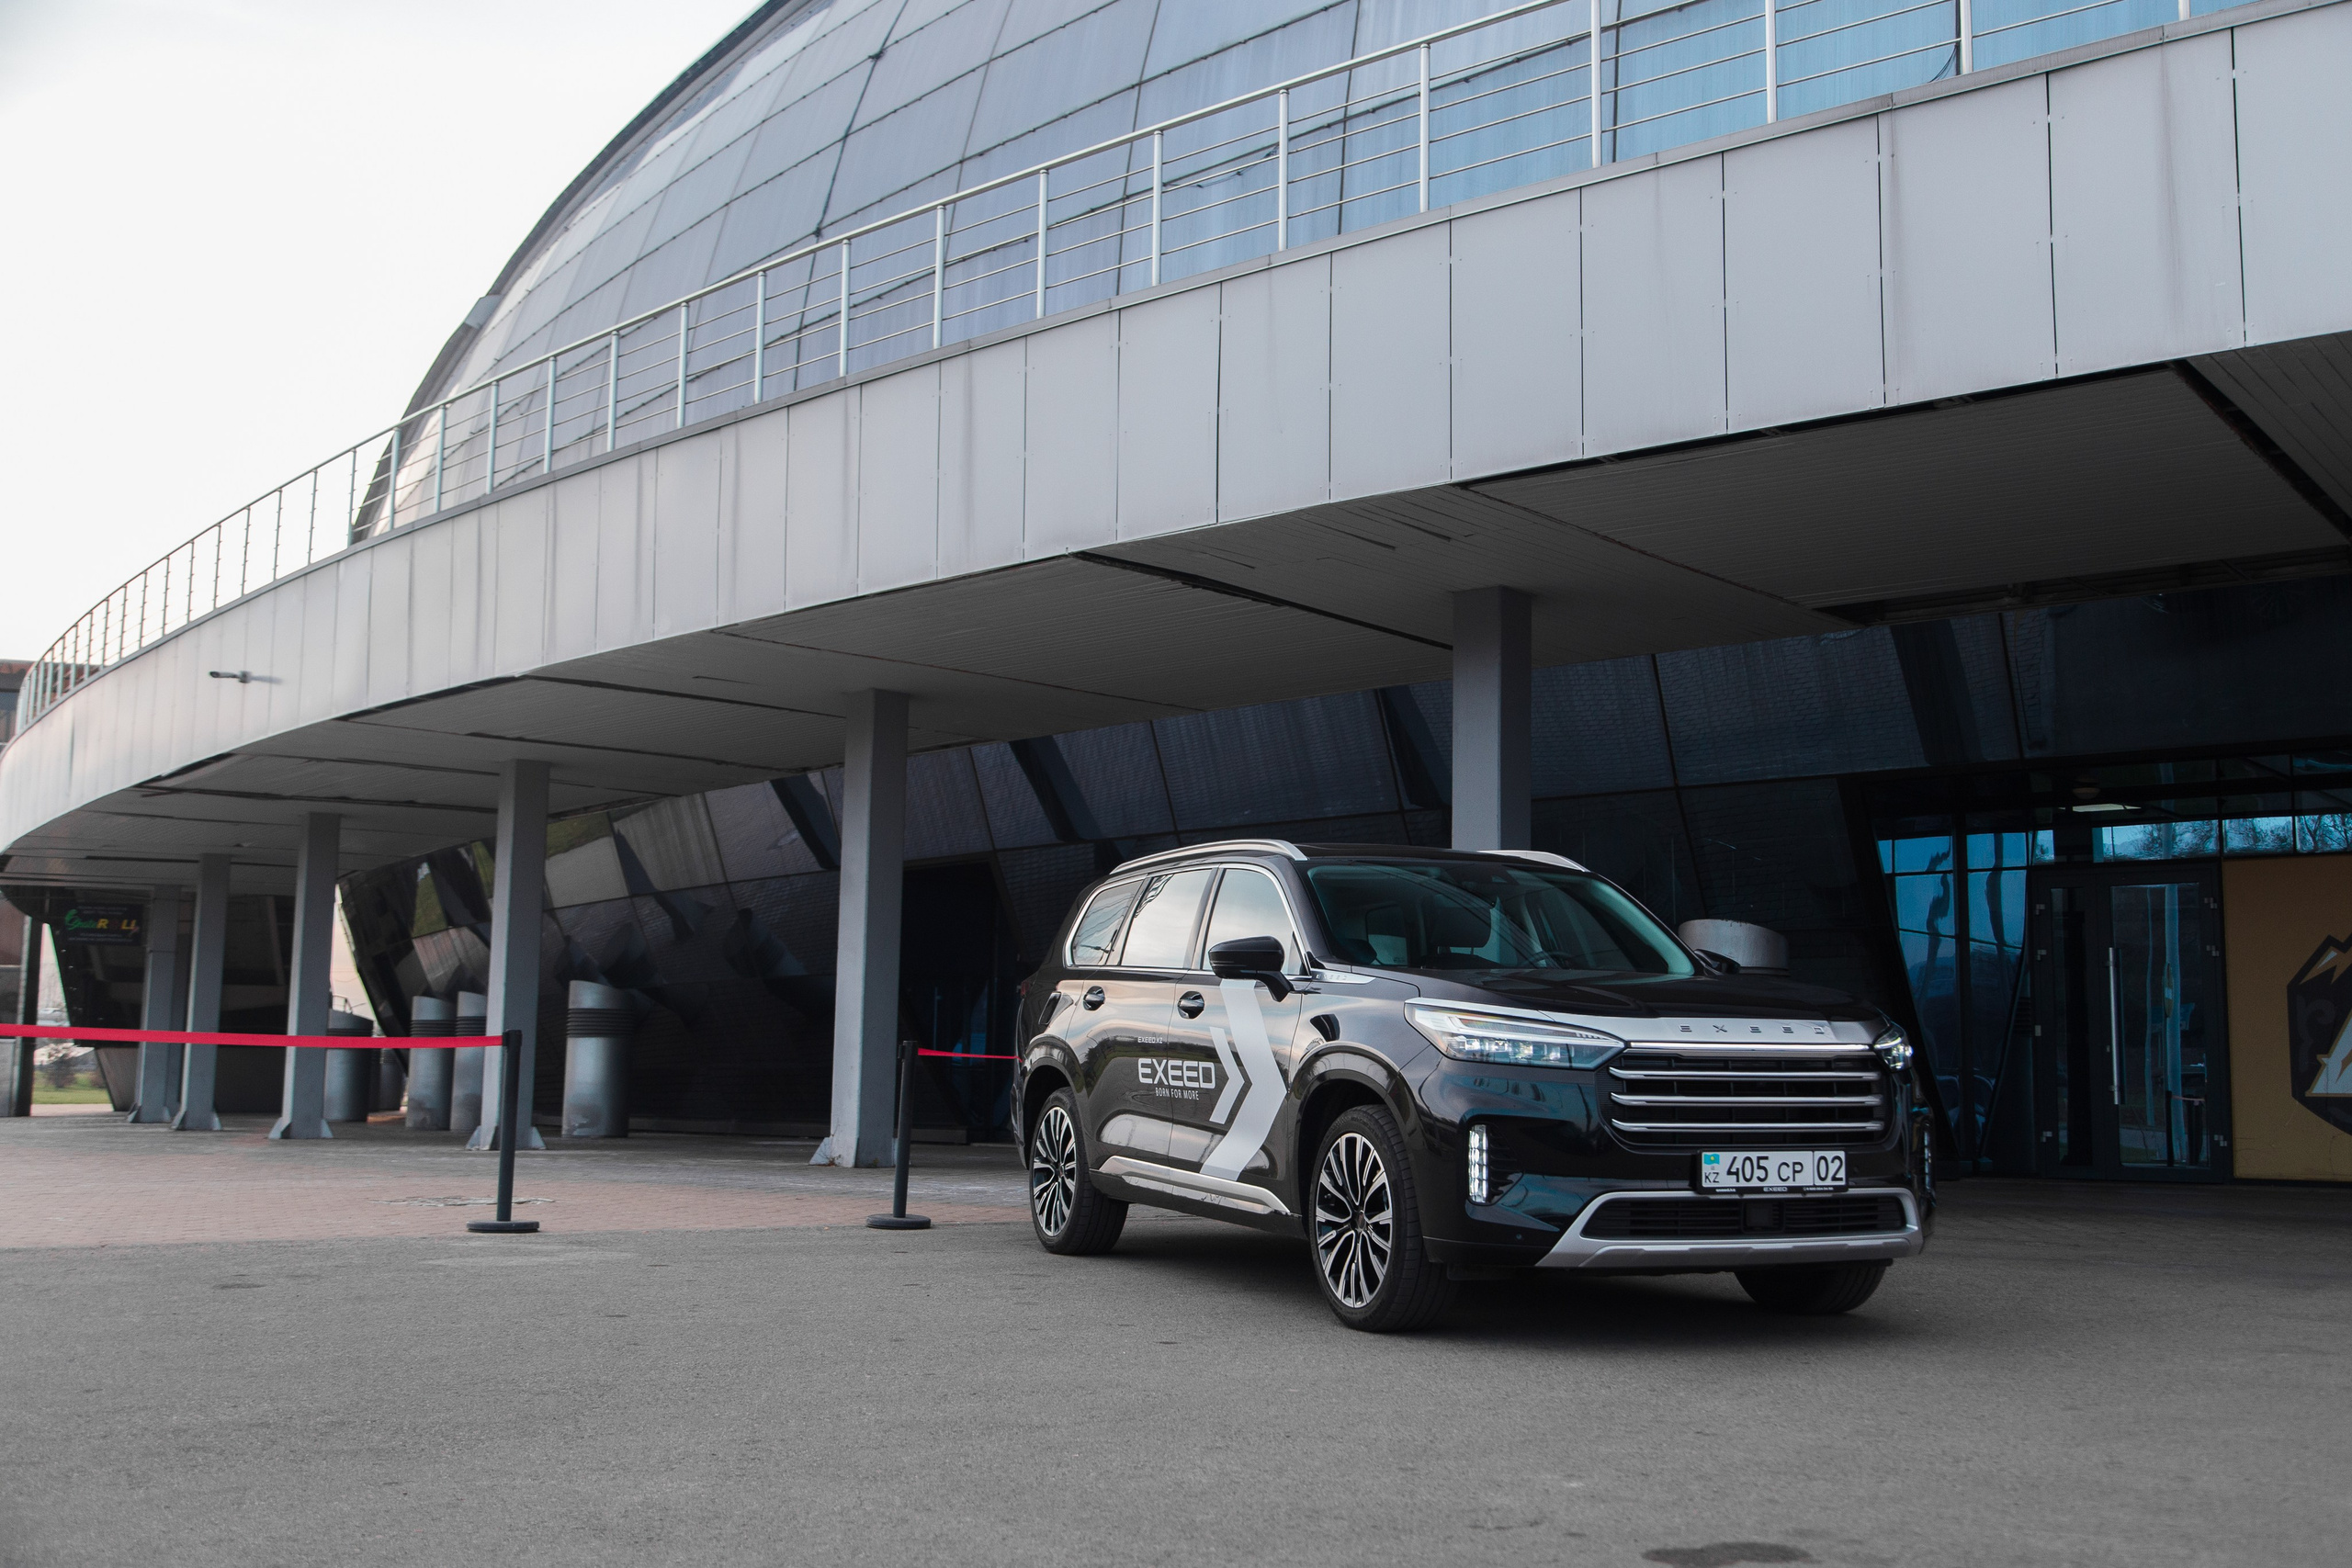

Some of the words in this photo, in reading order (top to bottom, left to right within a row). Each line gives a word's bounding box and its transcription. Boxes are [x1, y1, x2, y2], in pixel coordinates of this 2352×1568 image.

[1678, 1024, 1825, 1035] EXEED
[1137, 1057, 1216, 1089] EXEED
[1155, 1087, 1170, 1098] BORN
[1170, 1089, 1182, 1099] FOR
[1182, 1089, 1200, 1100] MORE
[1726, 1156, 1770, 1183] 405
[1777, 1161, 1804, 1182] CP
[1816, 1155, 1844, 1182] 02
[1704, 1171, 1720, 1183] KZ
